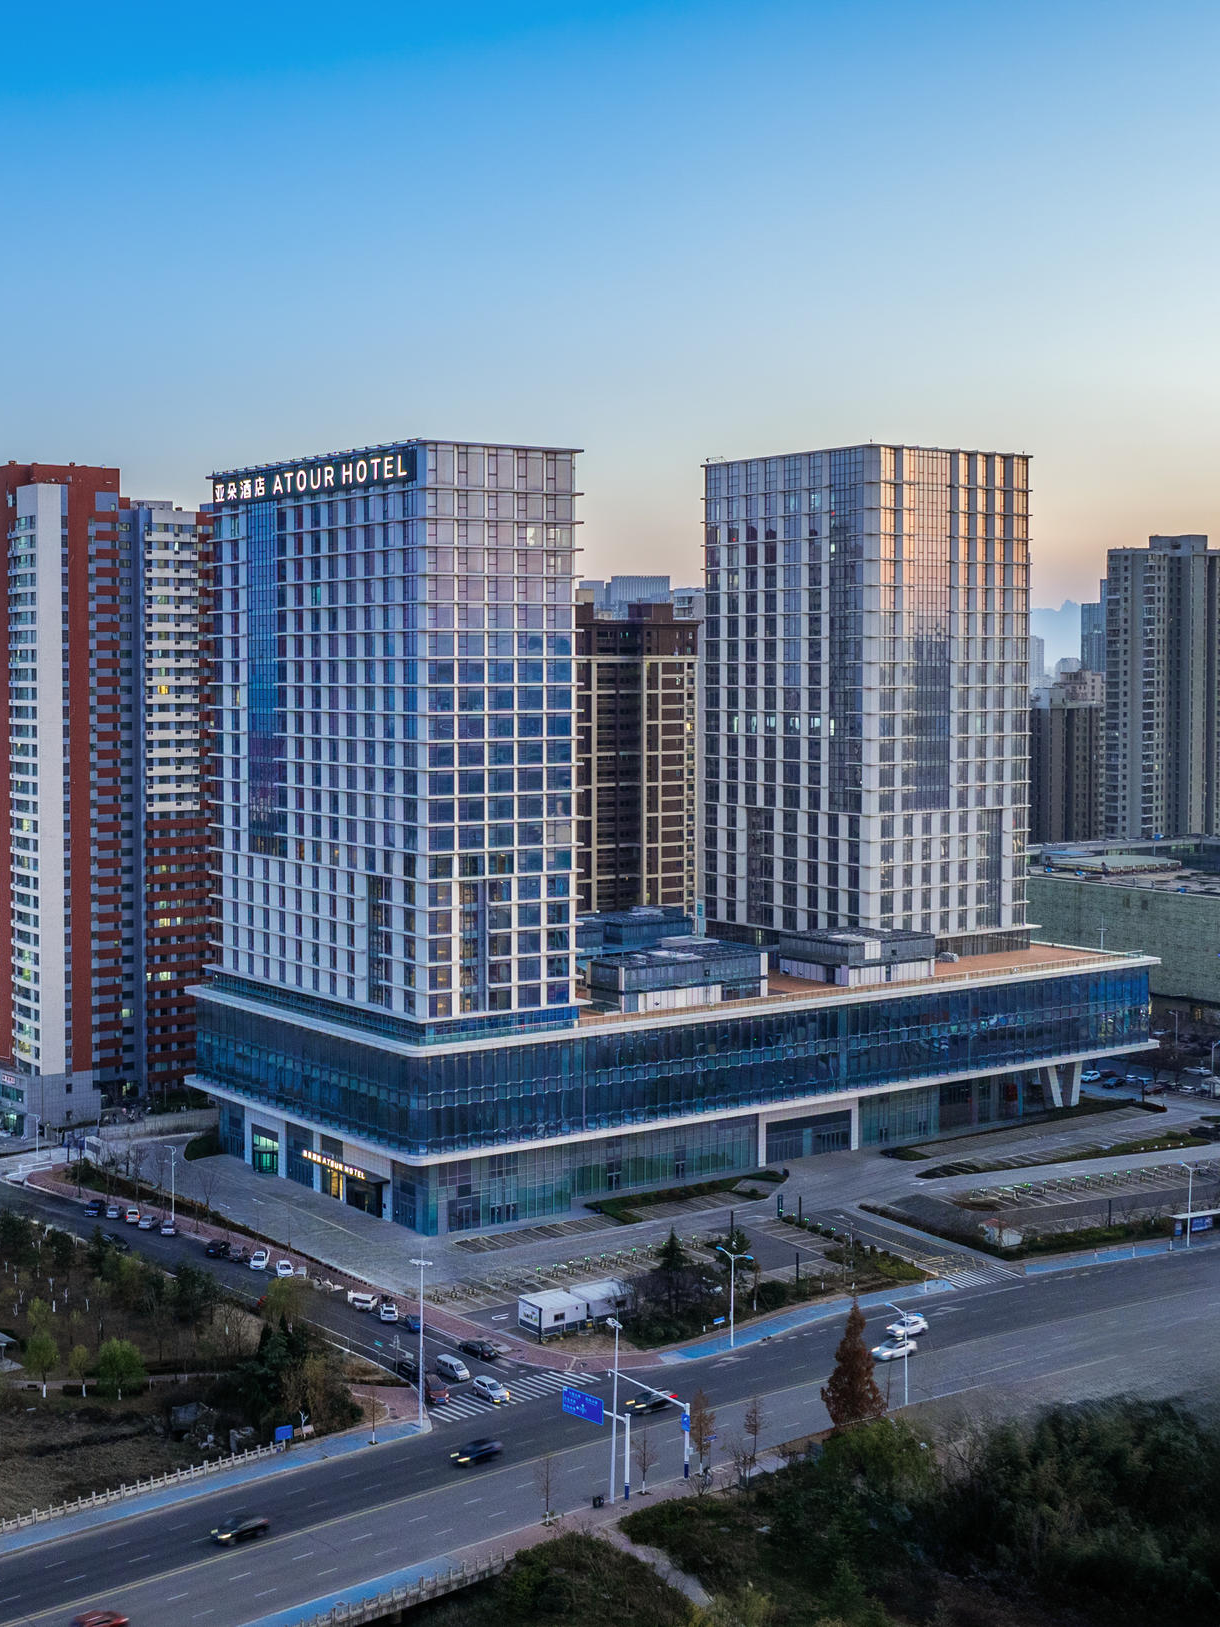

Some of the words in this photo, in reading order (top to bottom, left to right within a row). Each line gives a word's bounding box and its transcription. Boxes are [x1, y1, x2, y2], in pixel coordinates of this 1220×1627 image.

[272, 466, 335, 495] ATOUR
[341, 454, 408, 485] HOTEL
[214, 476, 265, 502] 亚朵酒店
[344, 1165, 366, 1180] HOTEL
